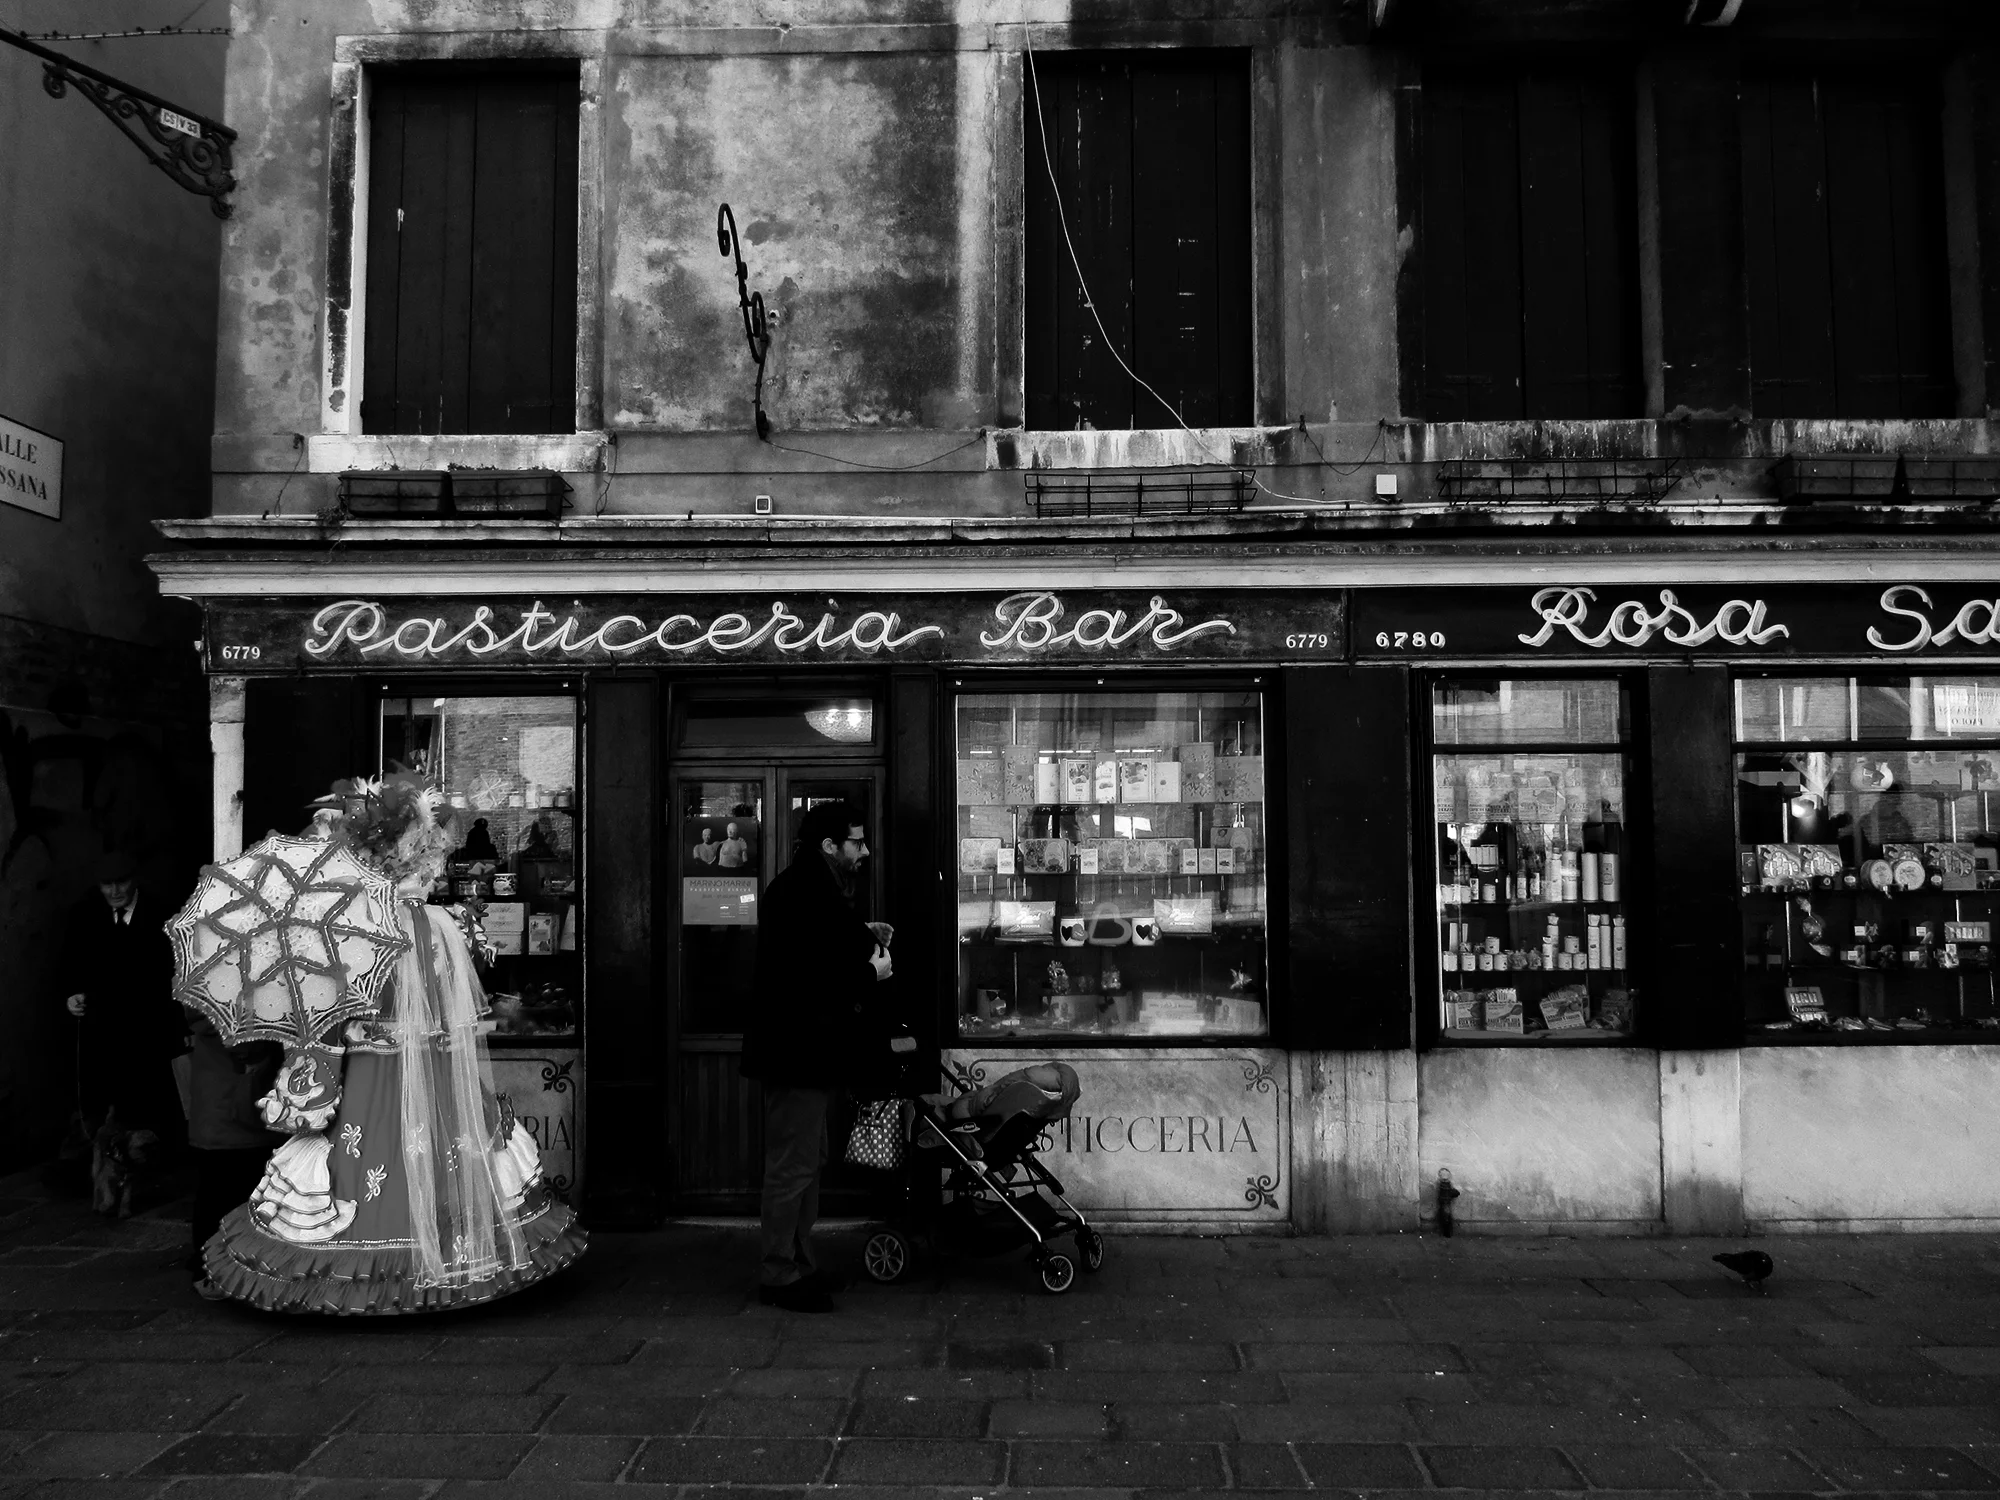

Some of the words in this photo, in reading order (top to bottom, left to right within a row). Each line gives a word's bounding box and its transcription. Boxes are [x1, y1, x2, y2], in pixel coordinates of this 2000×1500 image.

[0, 434, 37, 464] LLE
[304, 599, 944, 659] Pasticceria
[980, 591, 1237, 650] Bar
[1517, 586, 1790, 648] Rosa
[1285, 633, 1329, 649] 6779
[1375, 631, 1446, 649] 6780
[221, 645, 261, 660] 6779
